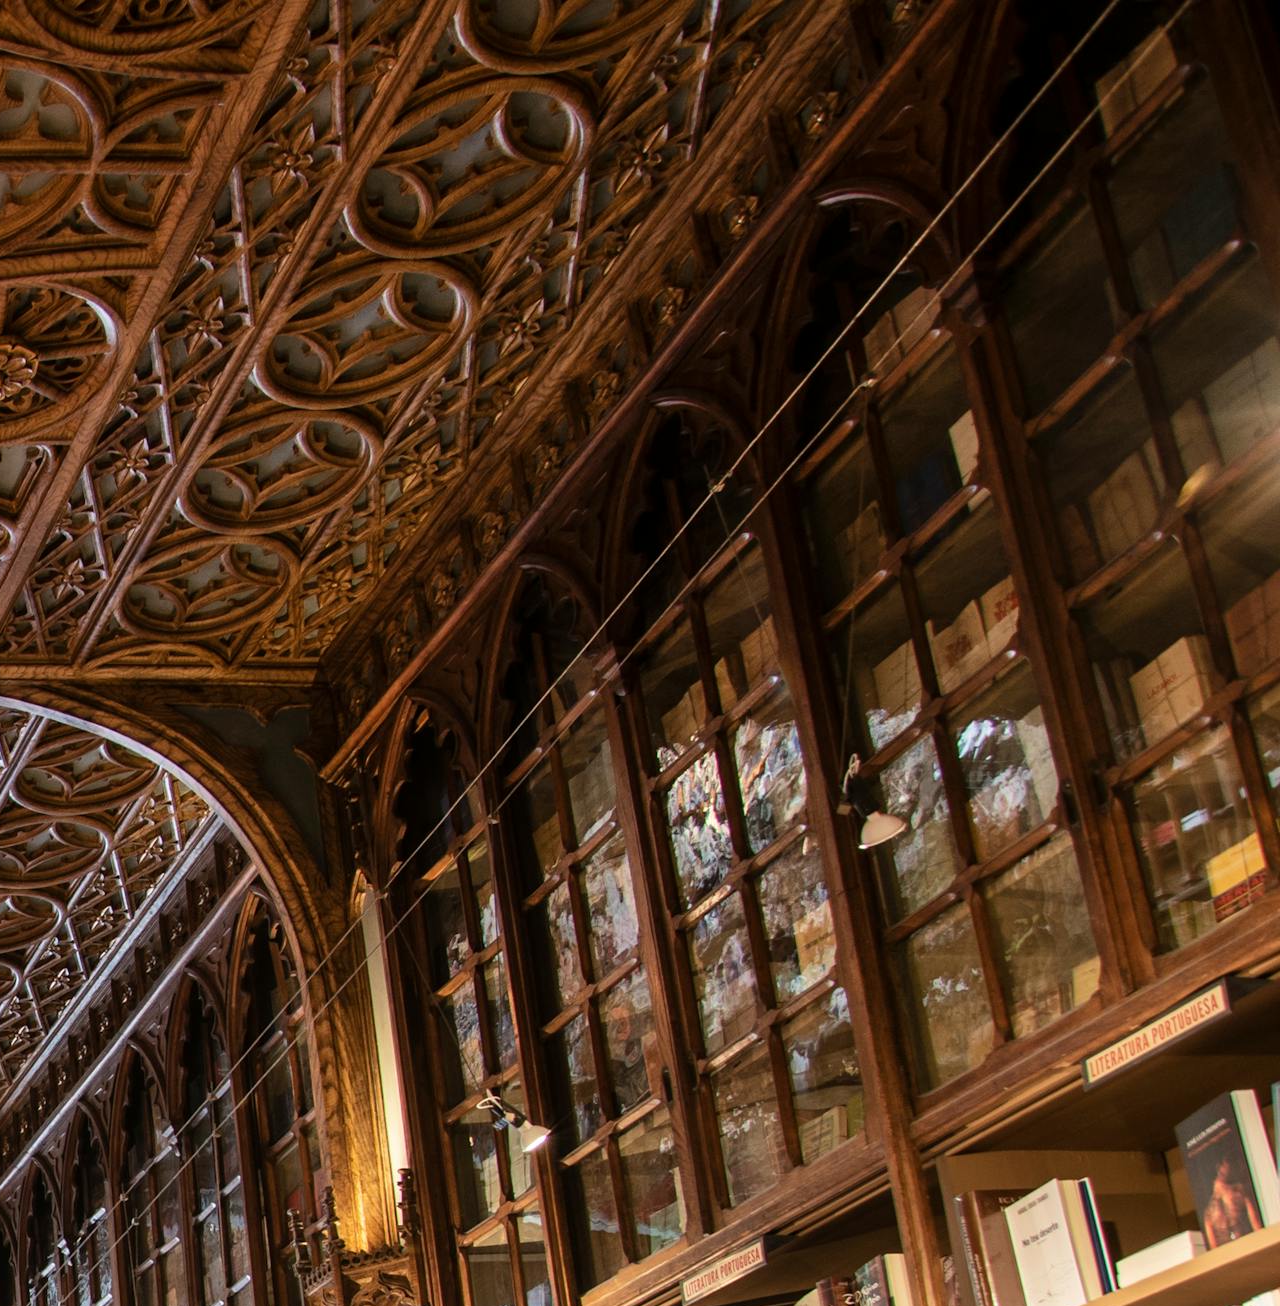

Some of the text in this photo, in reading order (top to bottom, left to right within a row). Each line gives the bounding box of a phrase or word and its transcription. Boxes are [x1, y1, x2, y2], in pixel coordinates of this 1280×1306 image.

[1089, 993, 1219, 1078] LITERATURA PORTUGUESA
[686, 1247, 761, 1298] LITERATURA PORTUGUESA
